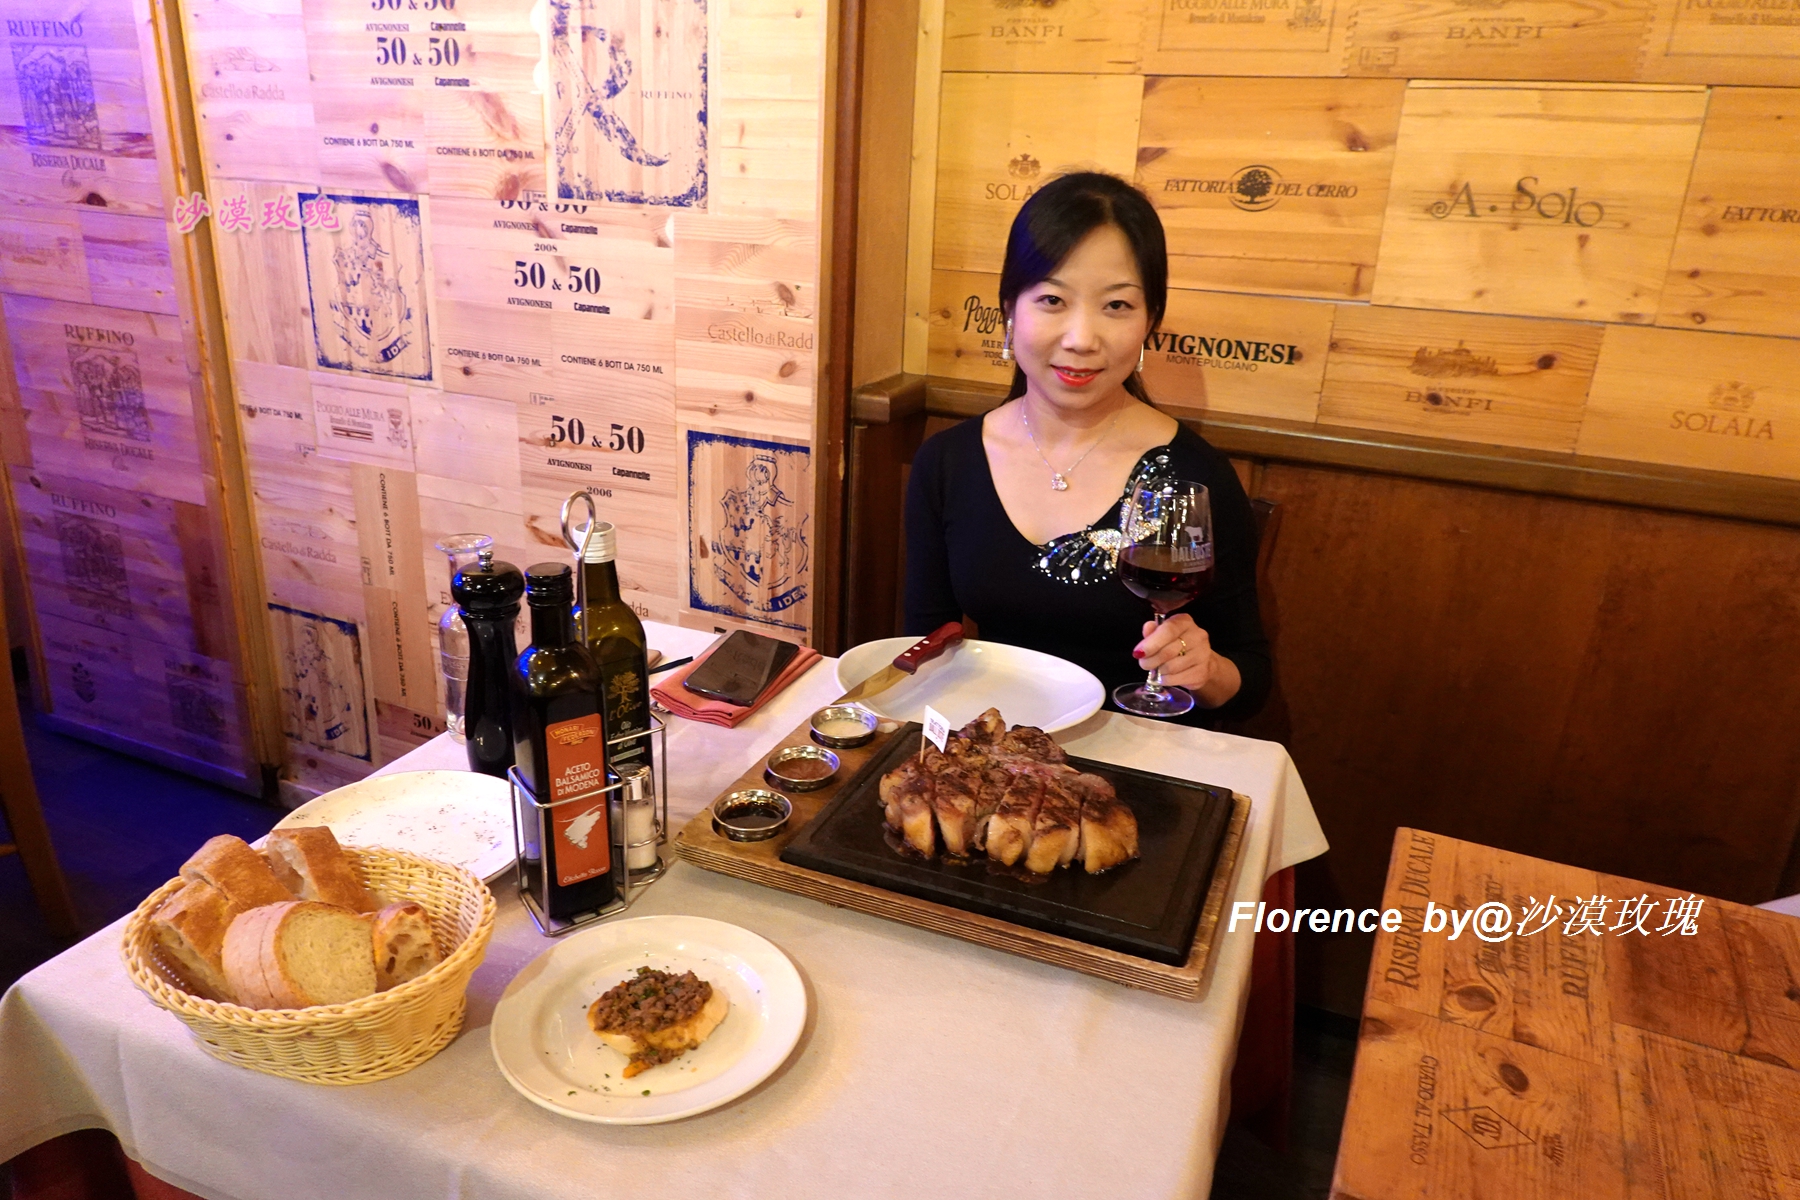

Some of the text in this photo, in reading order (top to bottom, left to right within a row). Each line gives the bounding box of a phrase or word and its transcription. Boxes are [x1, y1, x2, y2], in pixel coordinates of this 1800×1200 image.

[7, 20, 83, 38] RUFFINO
[365, 23, 410, 32] AVIGNONESI
[990, 25, 1064, 38] BANFI
[1445, 25, 1544, 40] BANFI
[376, 37, 460, 66] 50 & 50
[370, 77, 414, 87] AVIGNONESI
[641, 89, 693, 100] RUFFINO
[323, 137, 415, 149] CONTIENE 6 BOTT DA 750 ML
[436, 147, 471, 157] CONTIENE
[472, 148, 478, 157] 6
[479, 149, 495, 158] BOTT
[524, 150, 535, 160] ML
[1163, 179, 1358, 198] FATTORIA DEL CERRO
[1510, 176, 1604, 228] Solo
[1721, 206, 1800, 224] FATTOR
[493, 220, 539, 231] AVIGNONESI
[534, 243, 558, 253] 2008
[514, 260, 601, 295] 50 & 50
[507, 297, 552, 309] AVIGNONESI
[64, 324, 135, 346] RUFFINO
[708, 324, 814, 350] Castello di Radd
[447, 348, 542, 367] CONTIENE 6 BOTT DA 750 ML
[561, 355, 664, 375] CONTIENE 6 BOTT DA 750 ML
[1165, 354, 1259, 373] MONTEPULCIANO
[551, 415, 645, 454] 50 & 50
[1670, 410, 1775, 441] SOLAIA
[547, 458, 650, 481] AVIGNONESI Capannelle
[586, 486, 612, 498] 2006
[379, 472, 389, 510] CONTIENE
[386, 537, 392, 549] DA
[389, 565, 395, 576] ML
[392, 601, 400, 635] CONTIENE
[413, 713, 432, 731] 50
[555, 768, 600, 788] BALSAMICO
[565, 762, 591, 777] ACETO
[565, 778, 600, 794] MODENA
[1399, 833, 1436, 899] DUCALE
[1409, 1122, 1433, 1166] TASSO
